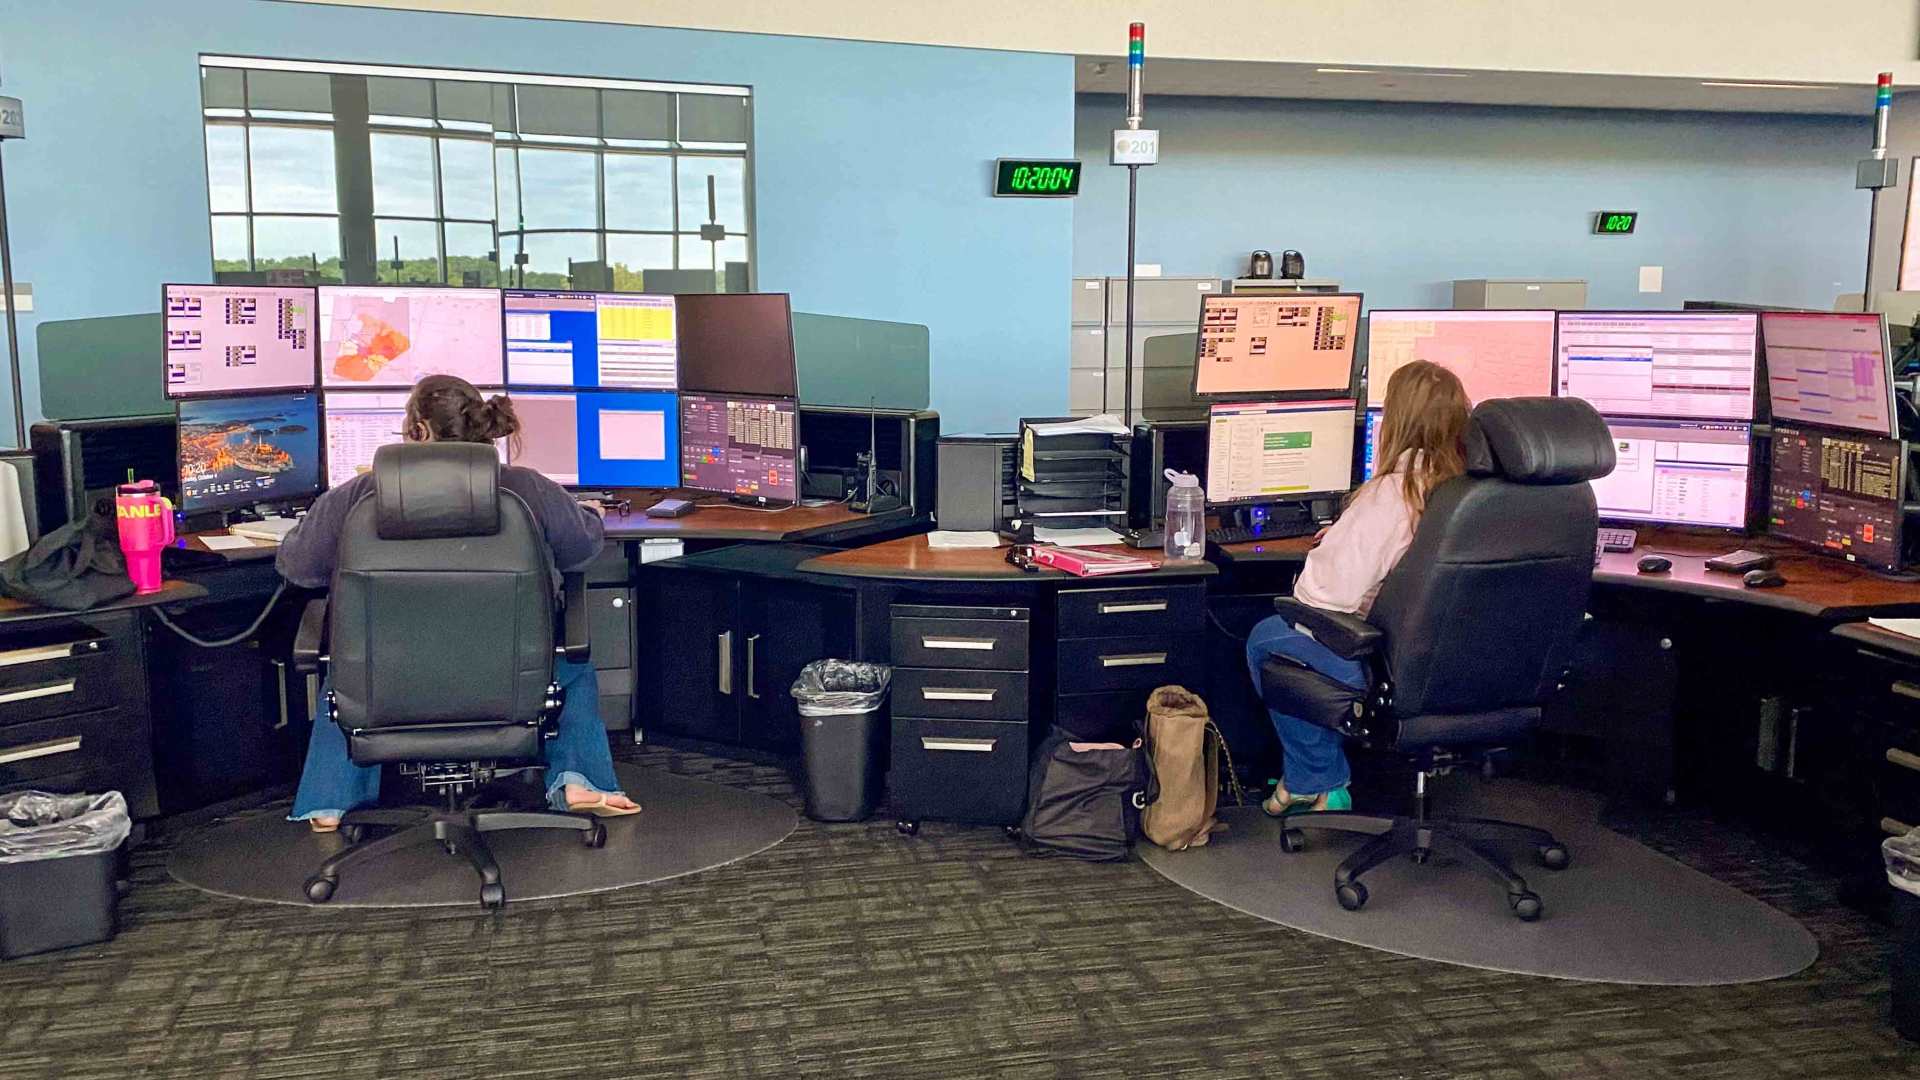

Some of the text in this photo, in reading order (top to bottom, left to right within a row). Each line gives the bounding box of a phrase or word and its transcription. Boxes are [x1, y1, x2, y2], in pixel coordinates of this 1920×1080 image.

[1131, 140, 1154, 153] 201
[1011, 166, 1074, 190] 10:20:04
[184, 462, 207, 474] 10:20
